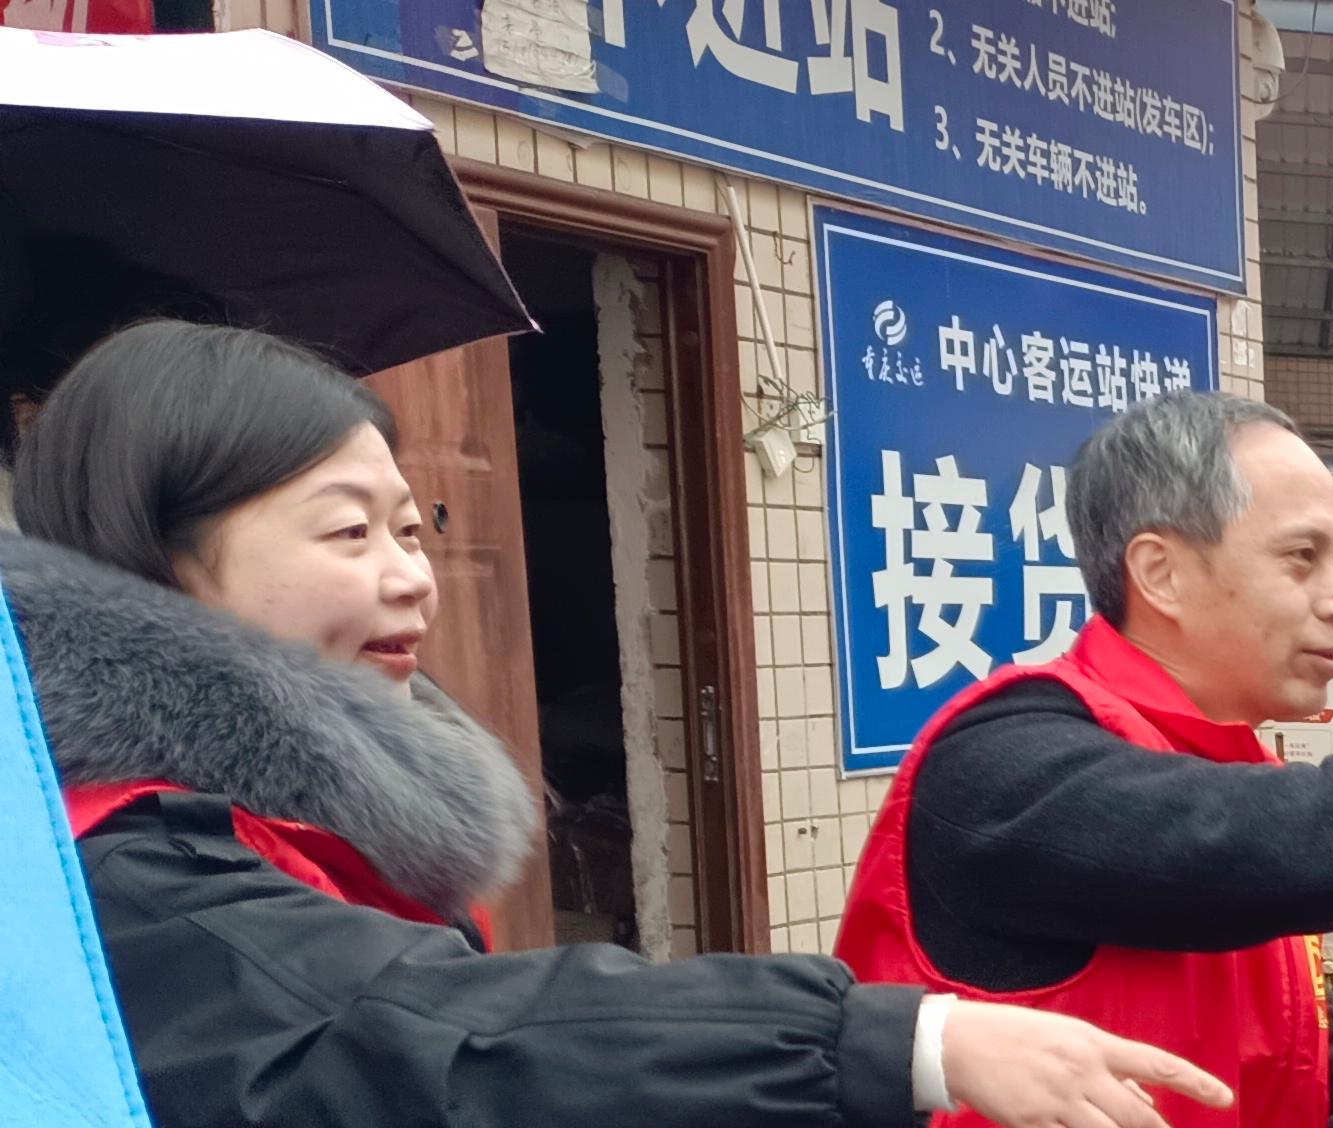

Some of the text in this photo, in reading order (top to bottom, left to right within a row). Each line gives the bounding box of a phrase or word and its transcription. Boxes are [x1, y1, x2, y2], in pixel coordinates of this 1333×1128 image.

[600, 0, 905, 132] 进站
[934, 105, 1148, 216] 3、无关车辆不进站。
[937, 314, 1192, 414] 中心客运站快递
